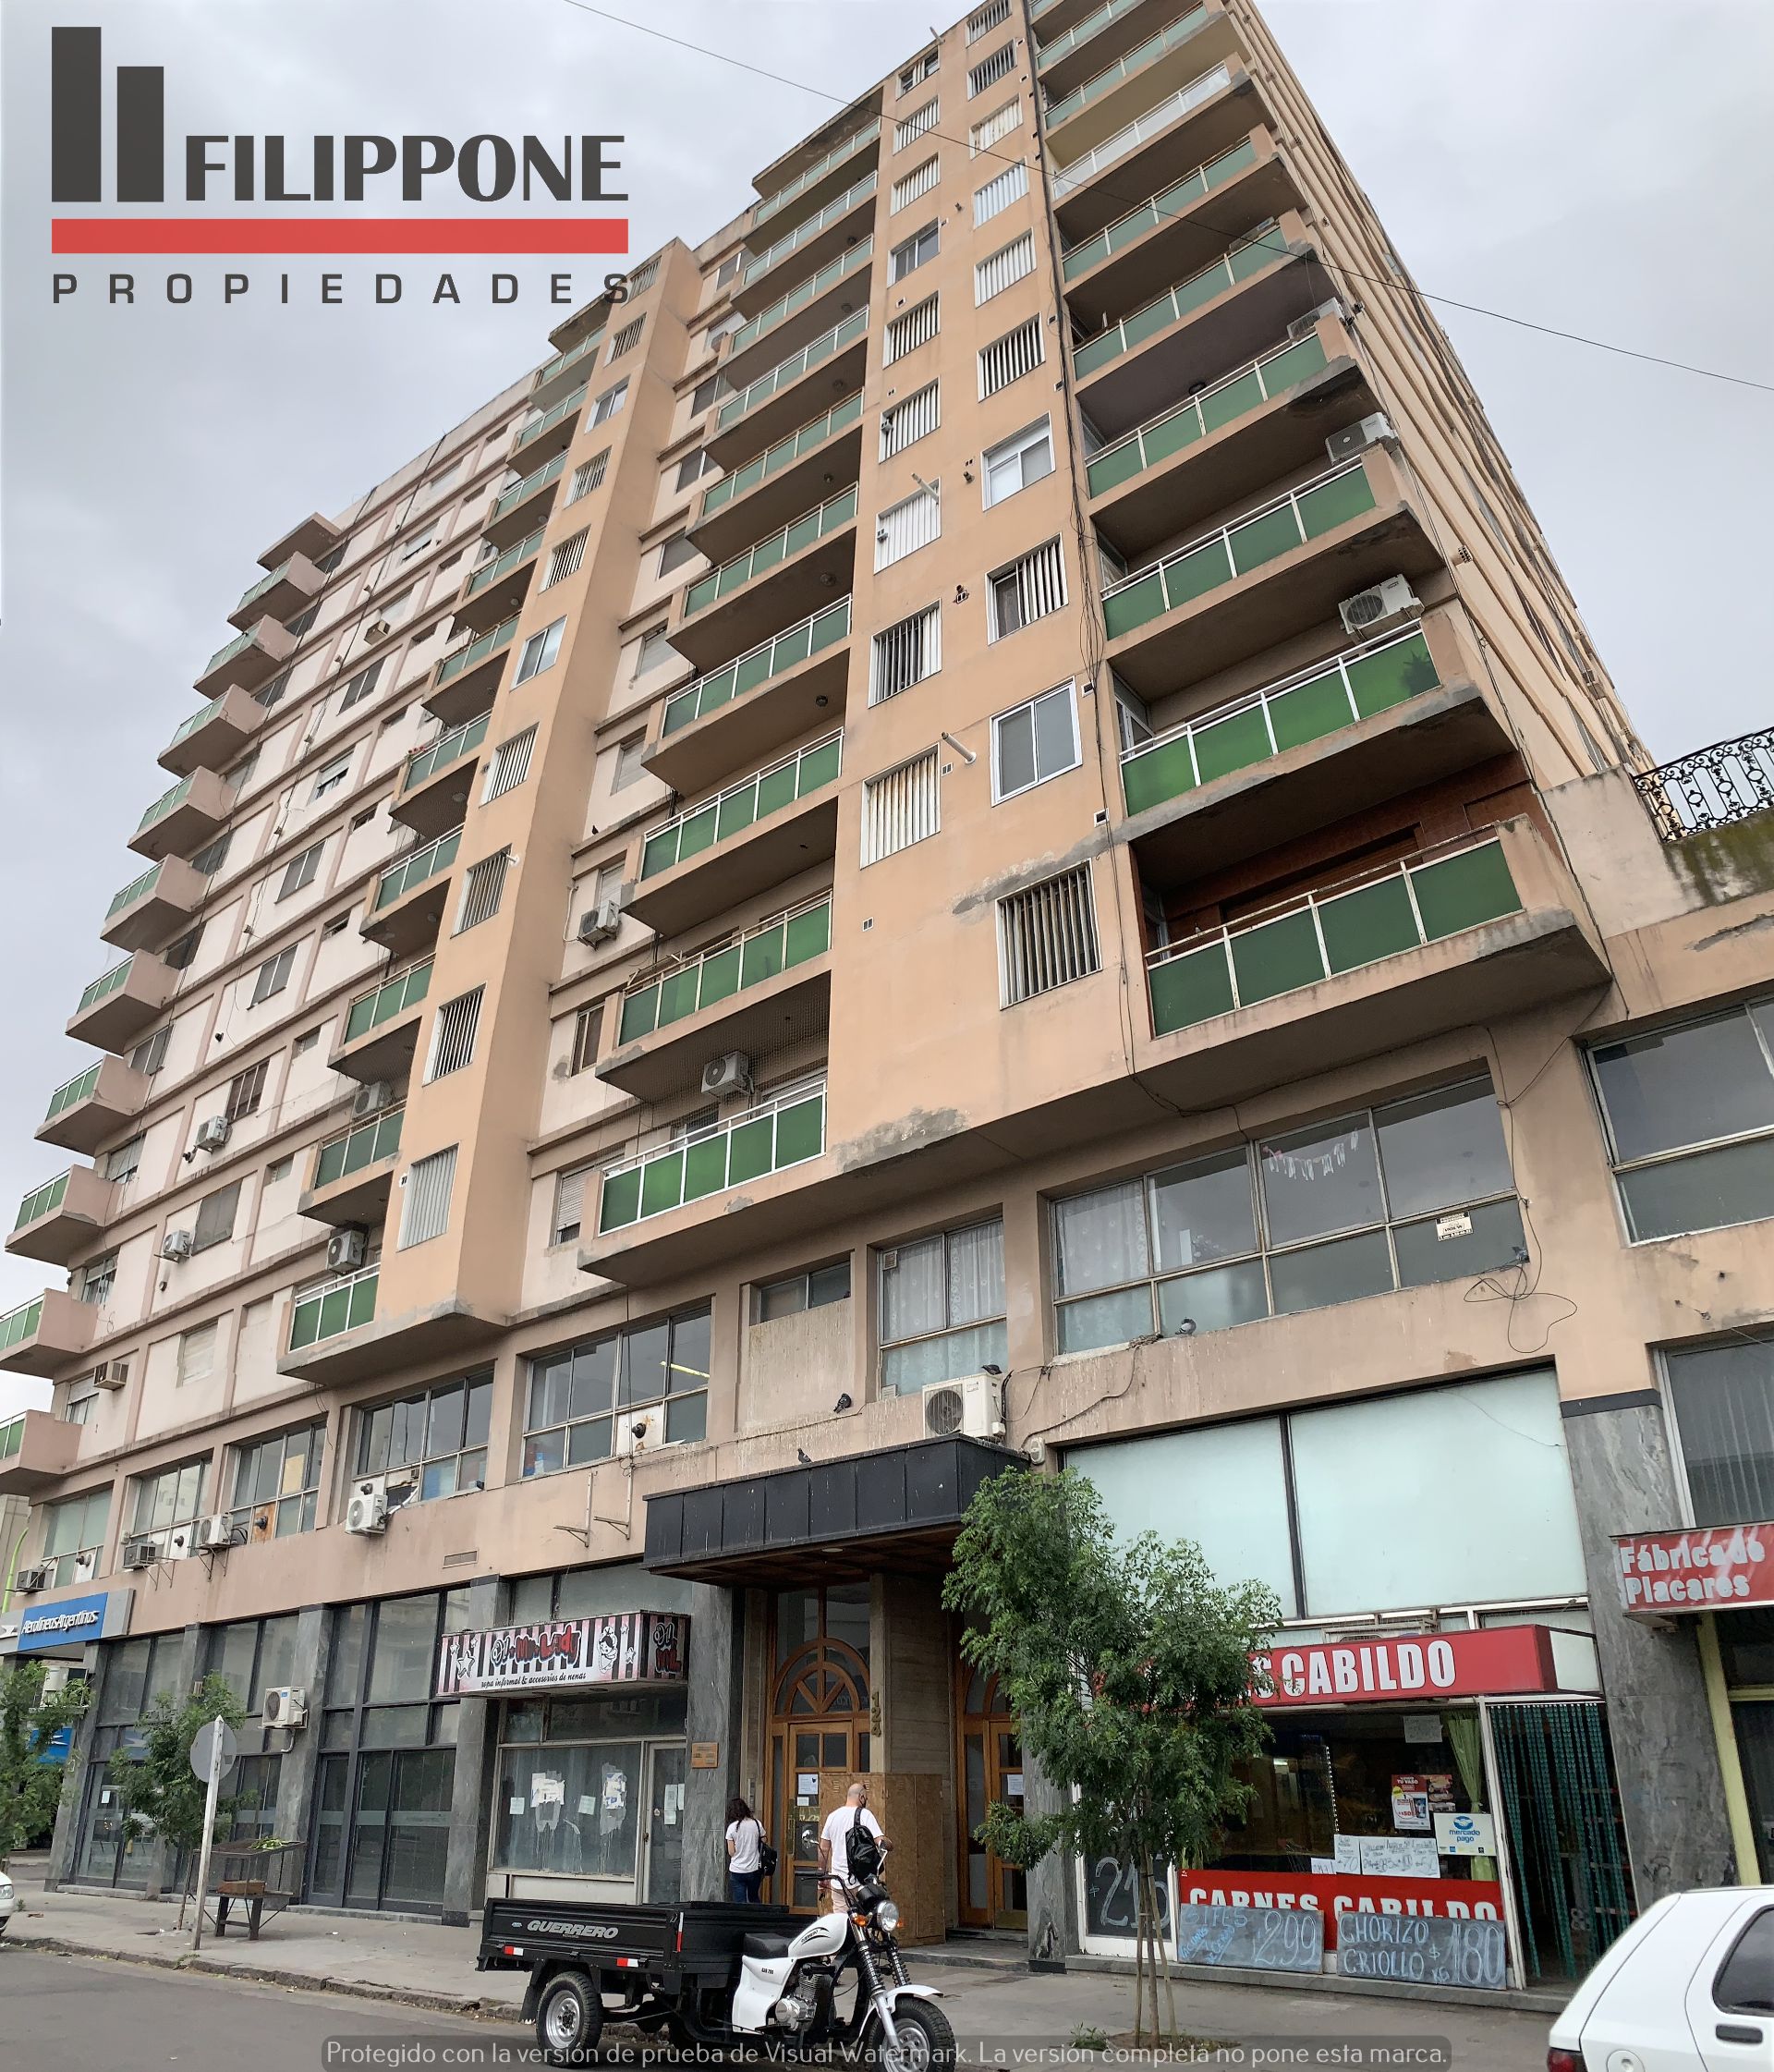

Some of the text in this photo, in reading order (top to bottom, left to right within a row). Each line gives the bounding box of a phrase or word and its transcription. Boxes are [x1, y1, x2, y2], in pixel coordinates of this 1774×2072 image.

[1620, 1542, 1725, 1574] Fábrica
[1624, 1575, 1750, 1604] Placares
[495, 1676, 520, 1688] informal
[529, 1673, 558, 1684] accesorios
[559, 1672, 565, 1681] de
[1282, 1639, 1456, 1698] CABILDO
[1456, 1835, 1475, 1844] pago
[527, 1920, 619, 1939] GUERRERO
[1340, 1913, 1429, 1944] CHORIZO
[1343, 1948, 1425, 1981] CRIOLLO
